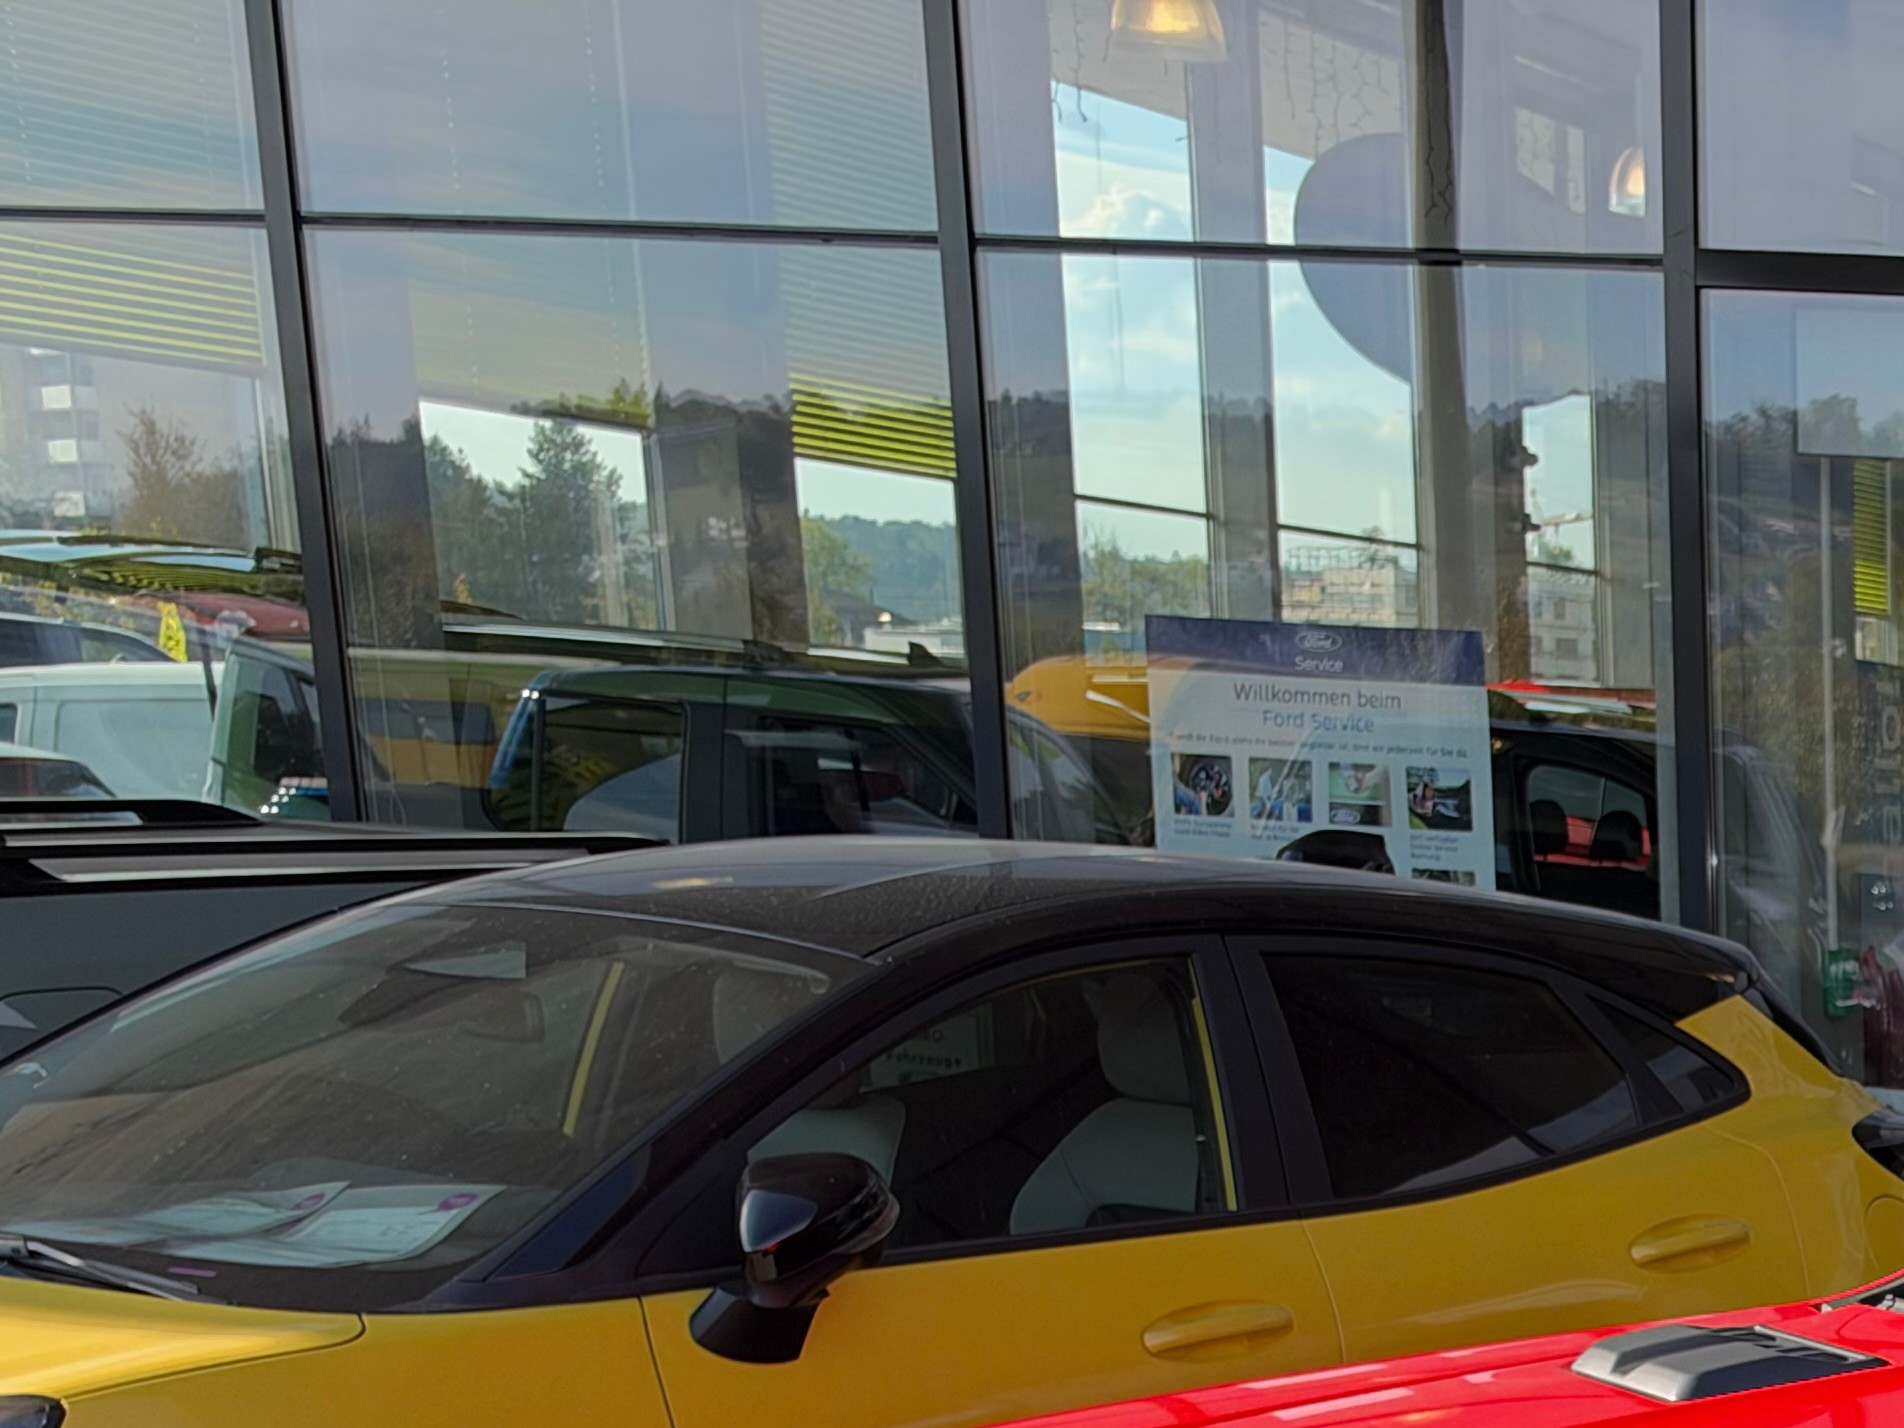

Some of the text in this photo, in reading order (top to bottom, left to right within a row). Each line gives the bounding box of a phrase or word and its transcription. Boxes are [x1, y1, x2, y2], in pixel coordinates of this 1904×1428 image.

[1295, 657, 1343, 673] Service
[1233, 682, 1401, 709] Willkommen beim
[1262, 709, 1375, 733] Ford Service
